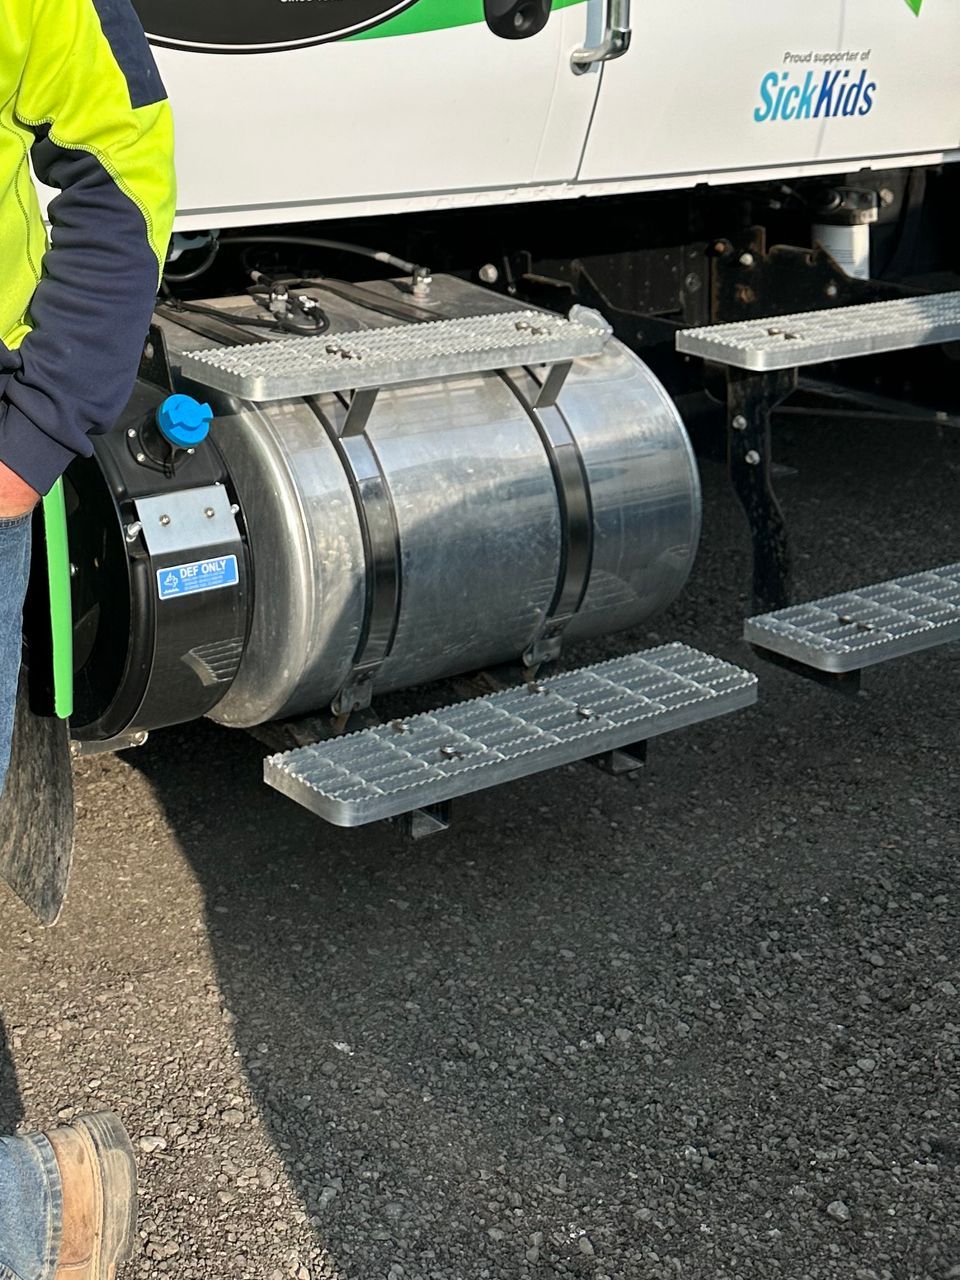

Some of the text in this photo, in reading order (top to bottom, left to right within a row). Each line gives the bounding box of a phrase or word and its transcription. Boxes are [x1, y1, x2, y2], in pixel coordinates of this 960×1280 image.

[783, 49, 871, 65] Proud supporter of
[754, 69, 877, 122] SickKids
[180, 560, 227, 579] DEF ONLY
